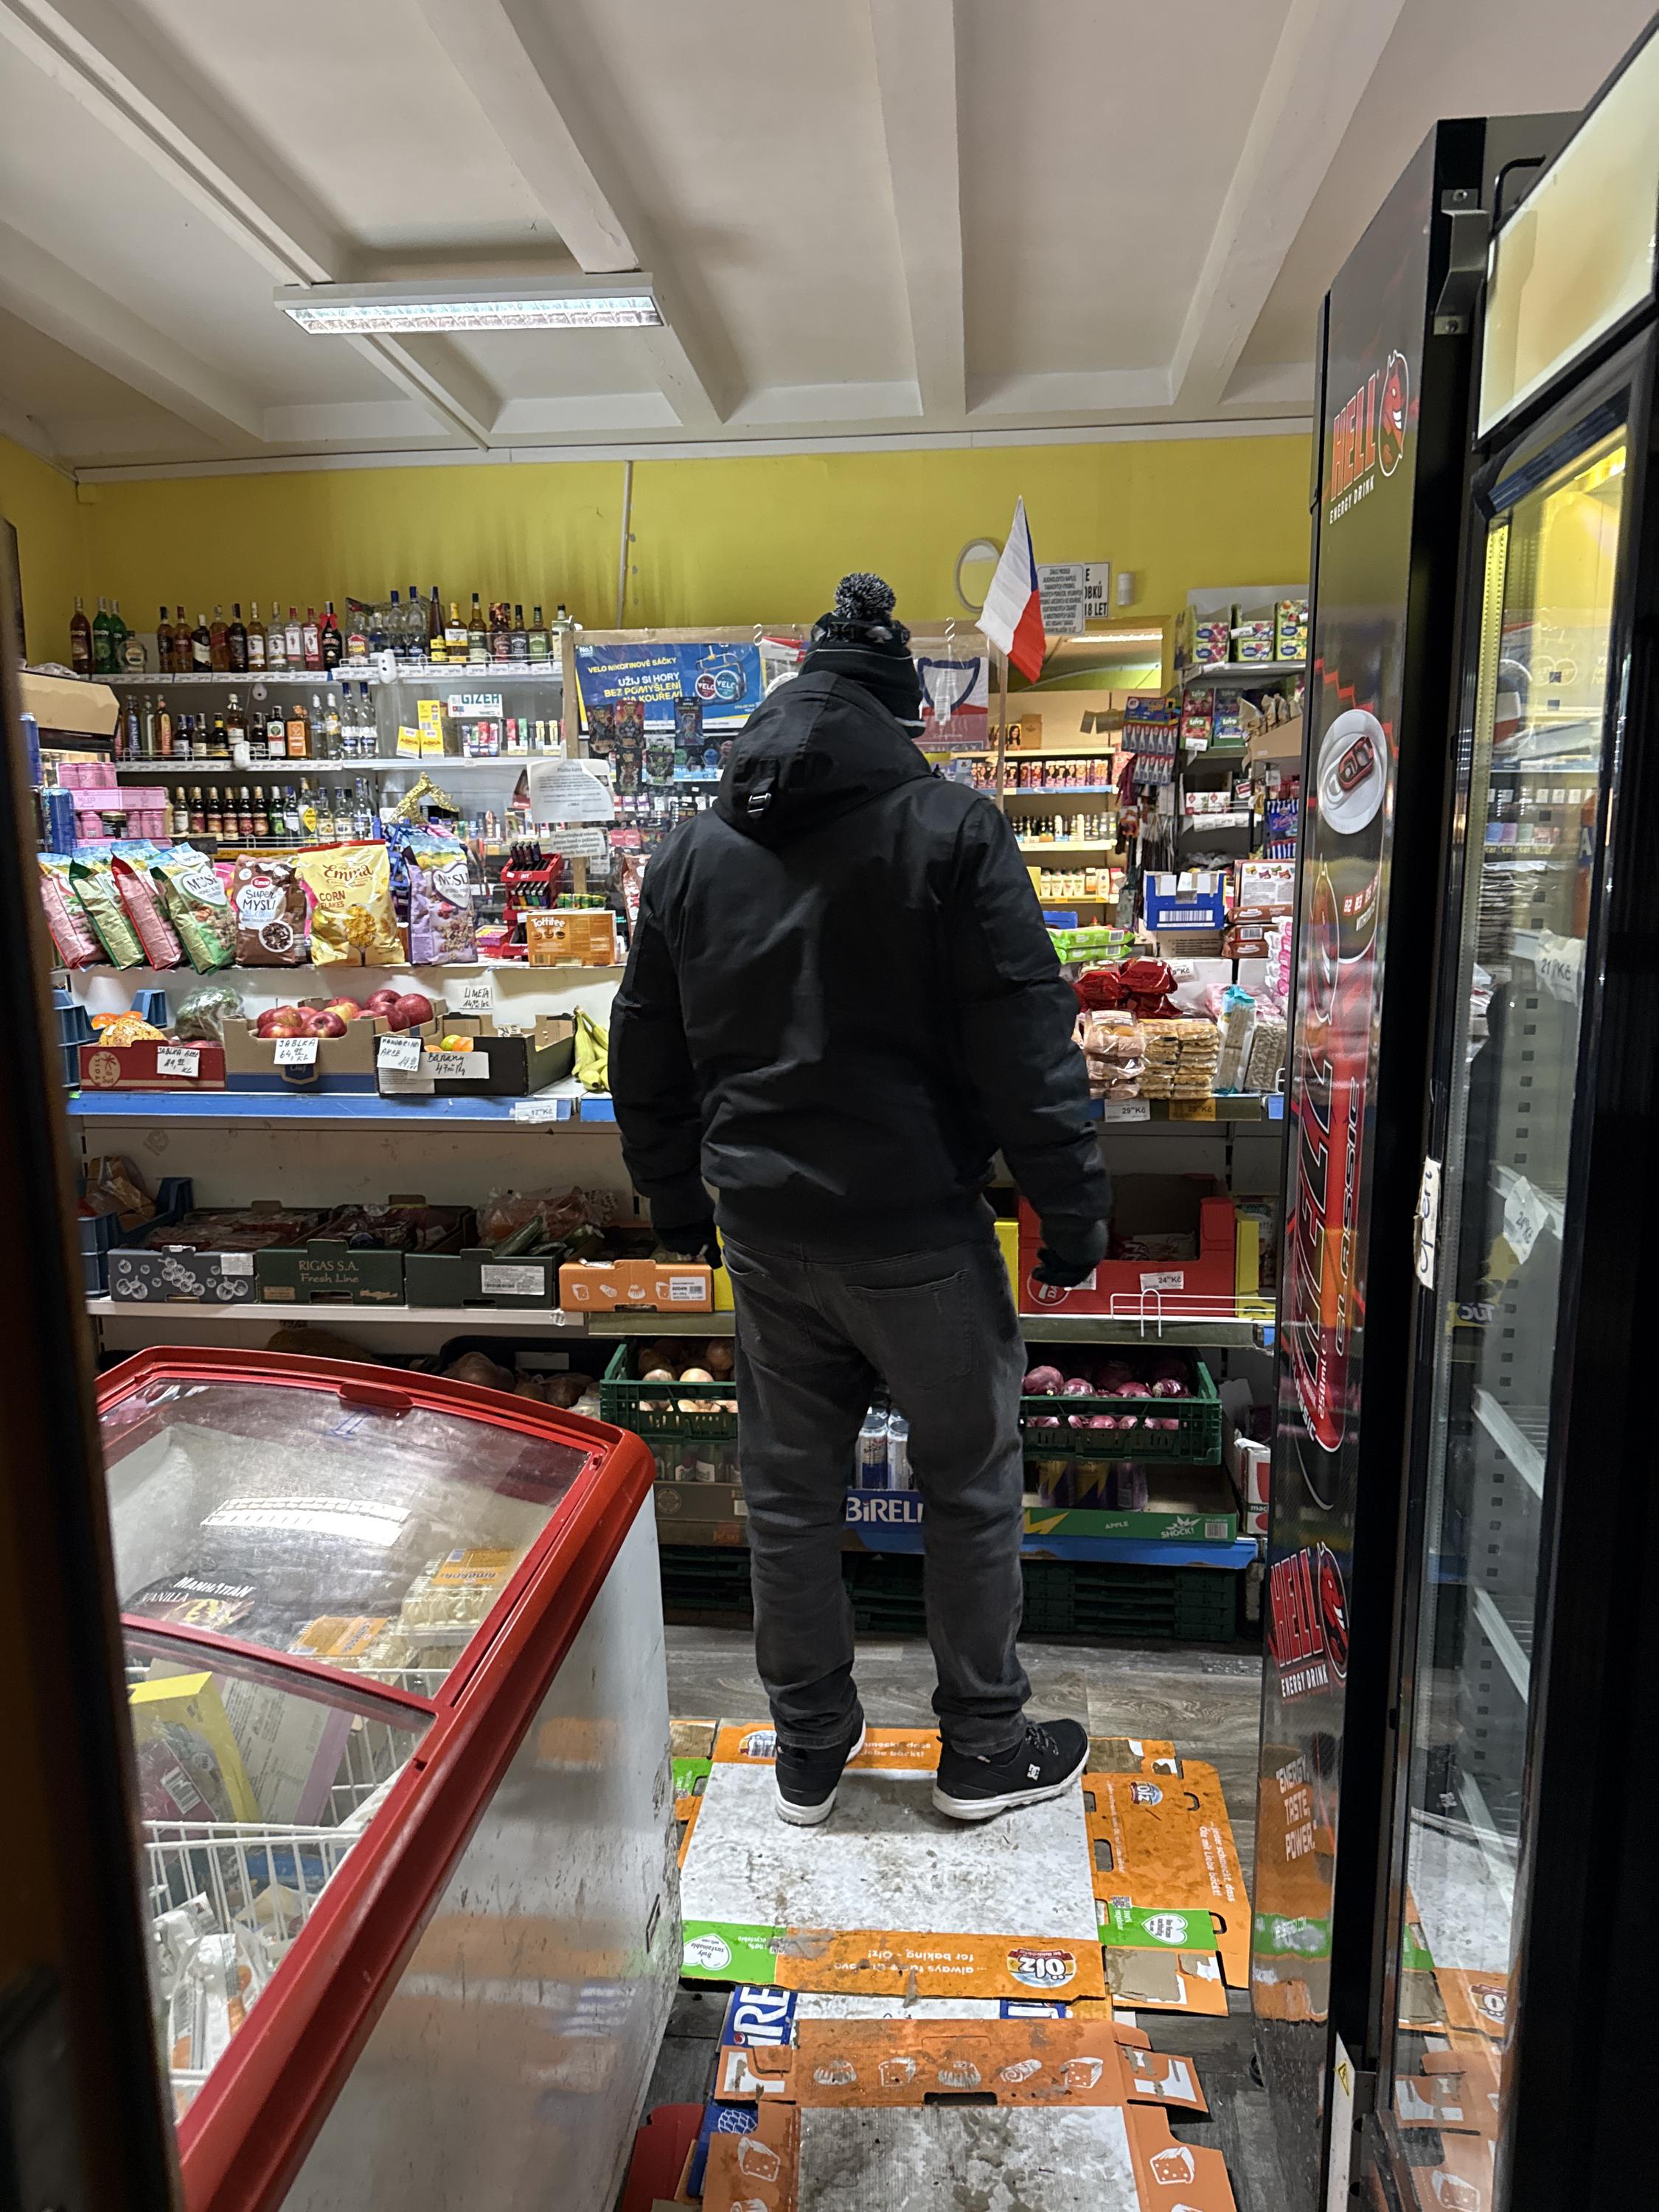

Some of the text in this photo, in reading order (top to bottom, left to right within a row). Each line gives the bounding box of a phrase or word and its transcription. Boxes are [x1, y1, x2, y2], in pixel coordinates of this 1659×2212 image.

[1330, 372, 1376, 503] HELL
[1329, 474, 1375, 525] ENERGY DRINK
[1094, 602, 1107, 616] LET
[588, 656, 677, 674] VELO NIKOTINOVÉ SÁČKY
[618, 672, 681, 687] UŽIJ SI HORY
[604, 680, 681, 698] BEZ POMYŠLENÍ
[246, 888, 277, 901] Super
[319, 890, 346, 902] CORN
[243, 899, 276, 911] MYSLI
[321, 900, 345, 910] FLAKES
[530, 917, 566, 928] Toffifee
[299, 1260, 359, 1272] RIGAS S.A.
[300, 1273, 360, 1284] Fresh Line
[1105, 1520, 1129, 1529] APPLE
[1161, 1528, 1195, 1539] SHOCK!
[173, 1576, 256, 1598] MANHATTAN
[142, 1592, 189, 1602] VANILLA
[1270, 1548, 1324, 1669] HELL
[1281, 1662, 1329, 1698] ENERGY DRINK
[858, 1749, 887, 1757] iebe
[1201, 1839, 1212, 1851] mit
[1203, 1851, 1215, 1871] Liebe
[1224, 1884, 1237, 1903] dass
[690, 1942, 725, 1953] sustainable
[698, 1950, 712, 1959] Truly
[905, 1949, 952, 1961] baking
[956, 1953, 974, 1961] for
[927, 1964, 974, 1975] always
[1018, 1955, 1066, 1980] Ölz
